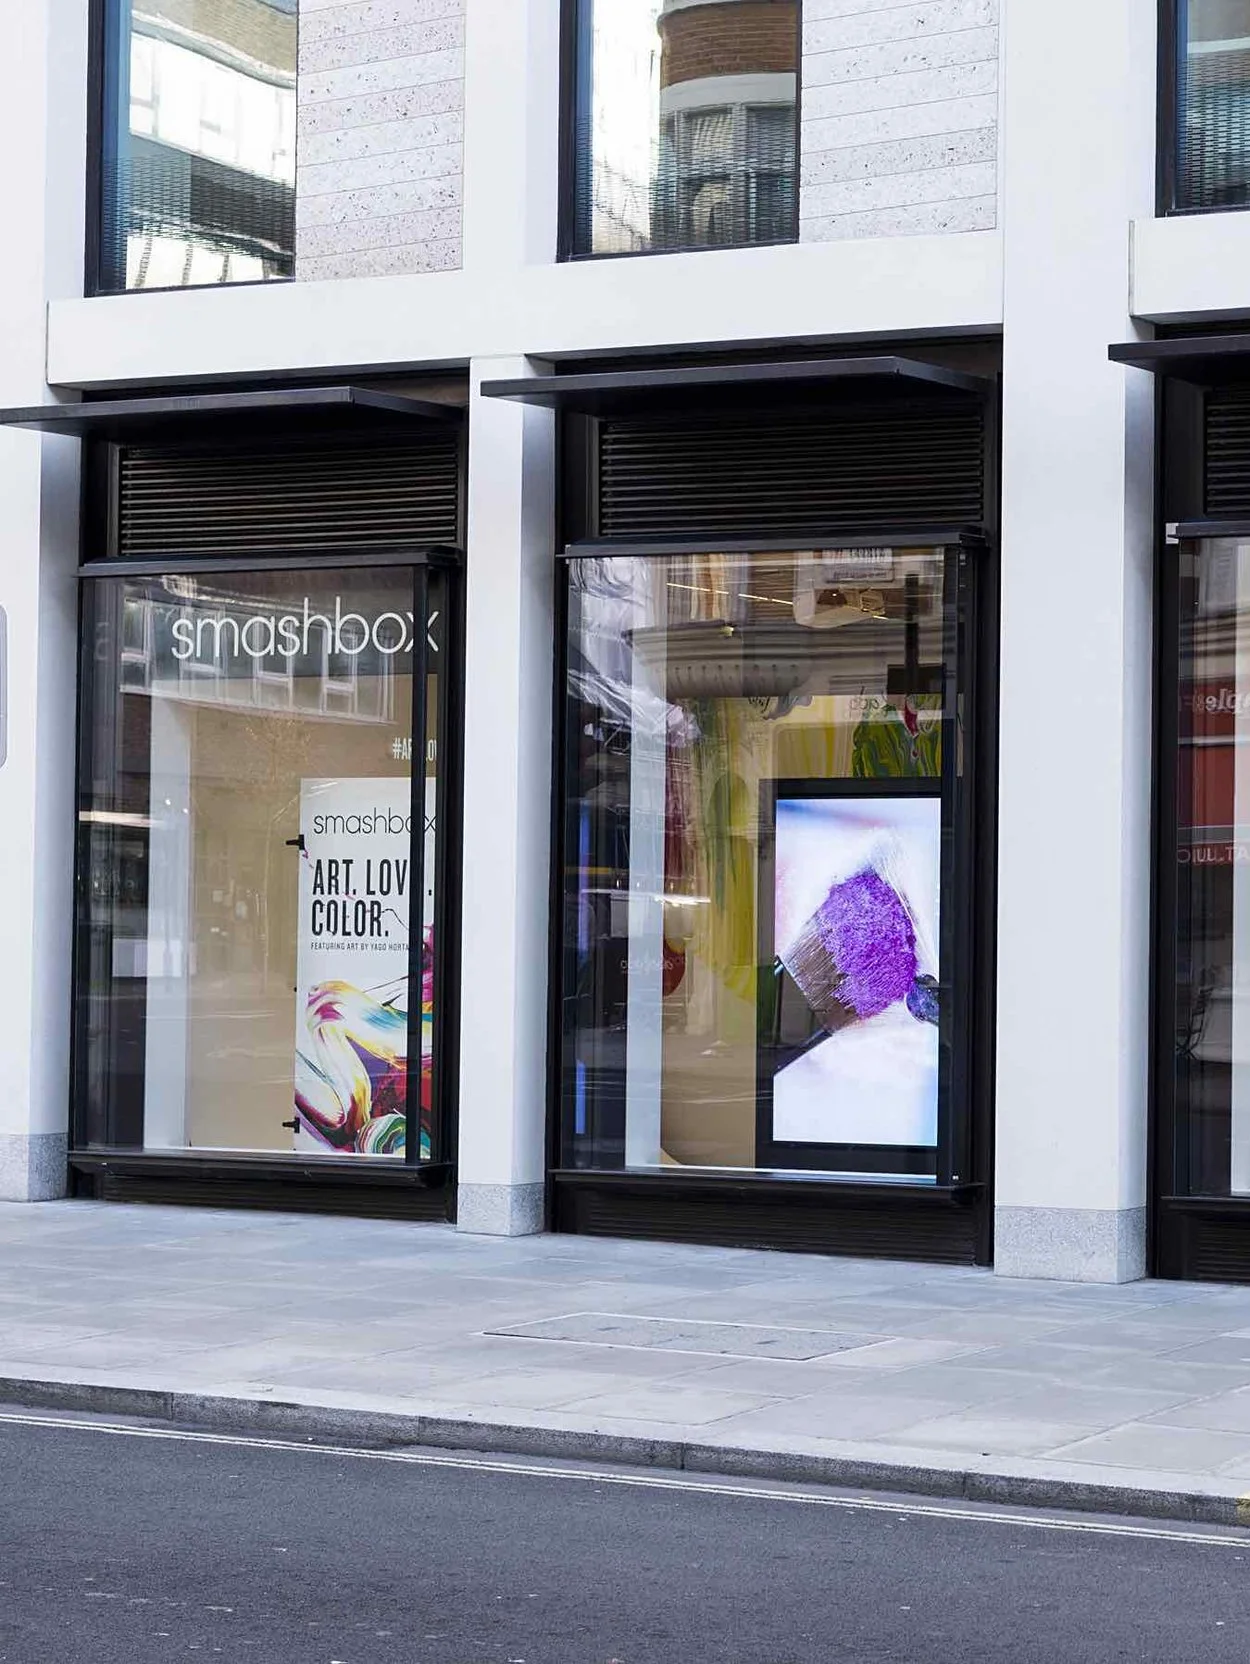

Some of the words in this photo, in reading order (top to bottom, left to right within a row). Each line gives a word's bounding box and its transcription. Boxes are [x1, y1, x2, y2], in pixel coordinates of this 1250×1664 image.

[171, 596, 439, 660] smashbox
[313, 859, 356, 895] ART.
[311, 899, 389, 937] COLOR.
[347, 942, 359, 952] ART
[361, 942, 369, 952] BY
